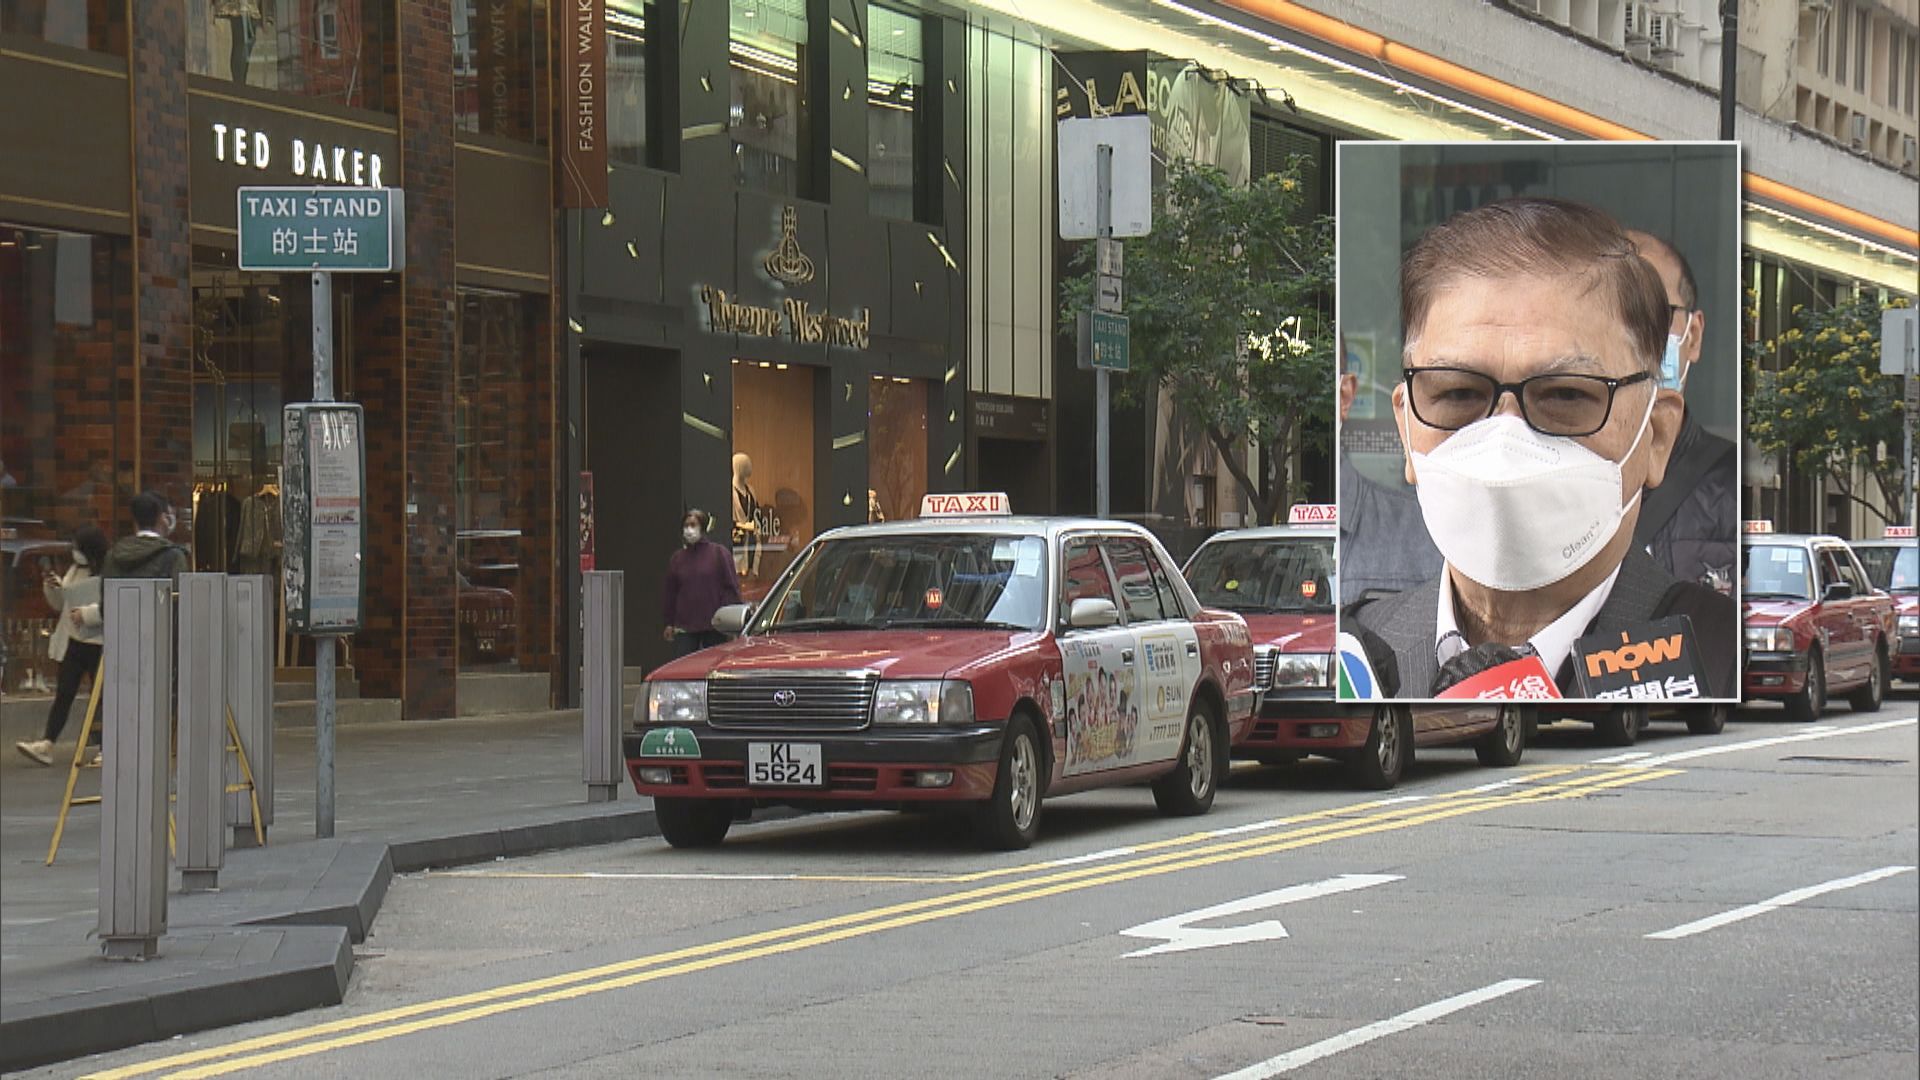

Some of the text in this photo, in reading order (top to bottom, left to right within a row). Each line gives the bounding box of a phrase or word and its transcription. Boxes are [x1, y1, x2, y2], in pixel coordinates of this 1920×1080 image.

[578, 0, 593, 151] FASHION WALK
[213, 123, 382, 189] TED BAKER
[247, 197, 382, 217] TAXI STAND
[272, 227, 358, 255] 的士站
[927, 495, 1000, 513] TAXI
[753, 507, 781, 537] Sale
[1887, 527, 1911, 535] TAXI
[926, 591, 942, 603] TAXI
[1585, 632, 1683, 681] now
[1165, 685, 1182, 702] SUN
[663, 729, 676, 746] 4
[770, 743, 801, 763] KL
[755, 762, 817, 784] 5624
